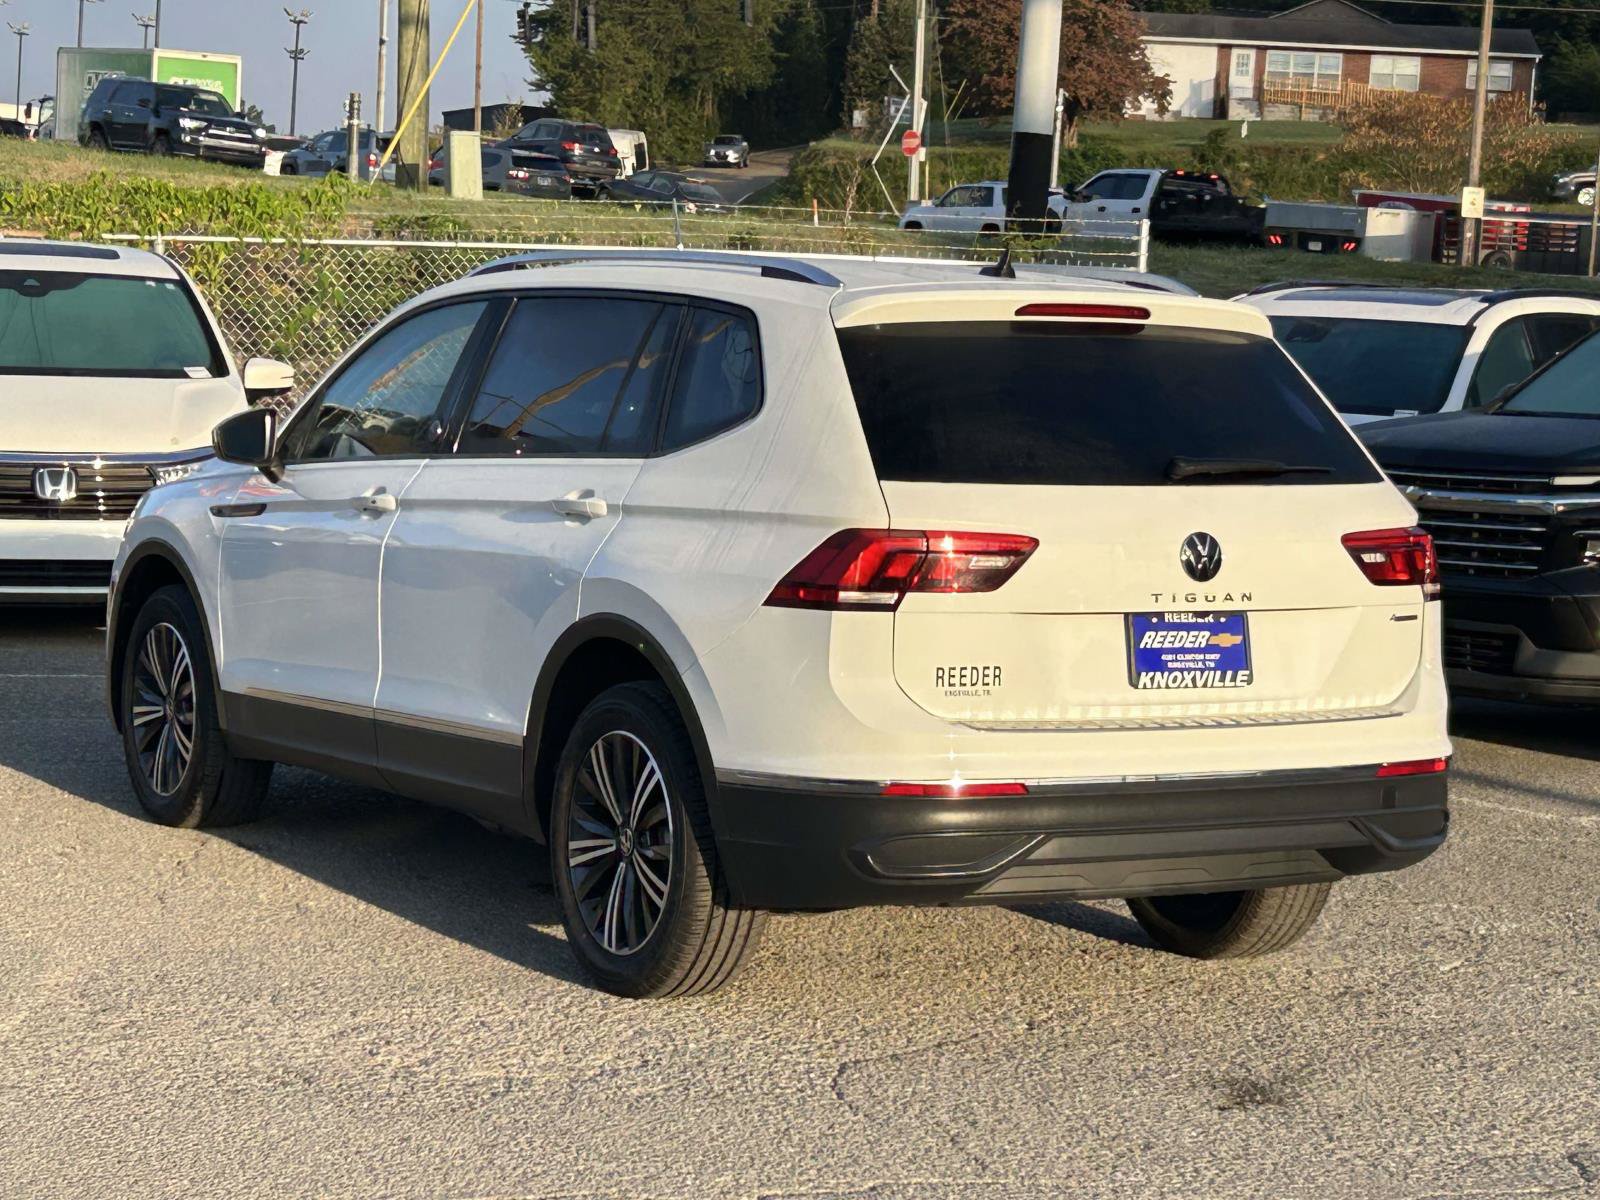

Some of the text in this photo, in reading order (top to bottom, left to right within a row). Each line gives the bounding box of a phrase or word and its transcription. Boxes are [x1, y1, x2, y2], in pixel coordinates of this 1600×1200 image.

[1150, 592, 1252, 603] TIGUAN
[1139, 630, 1211, 649] REEDER
[935, 665, 1002, 688] REEDER
[1137, 670, 1250, 689] KNOXVILLE
